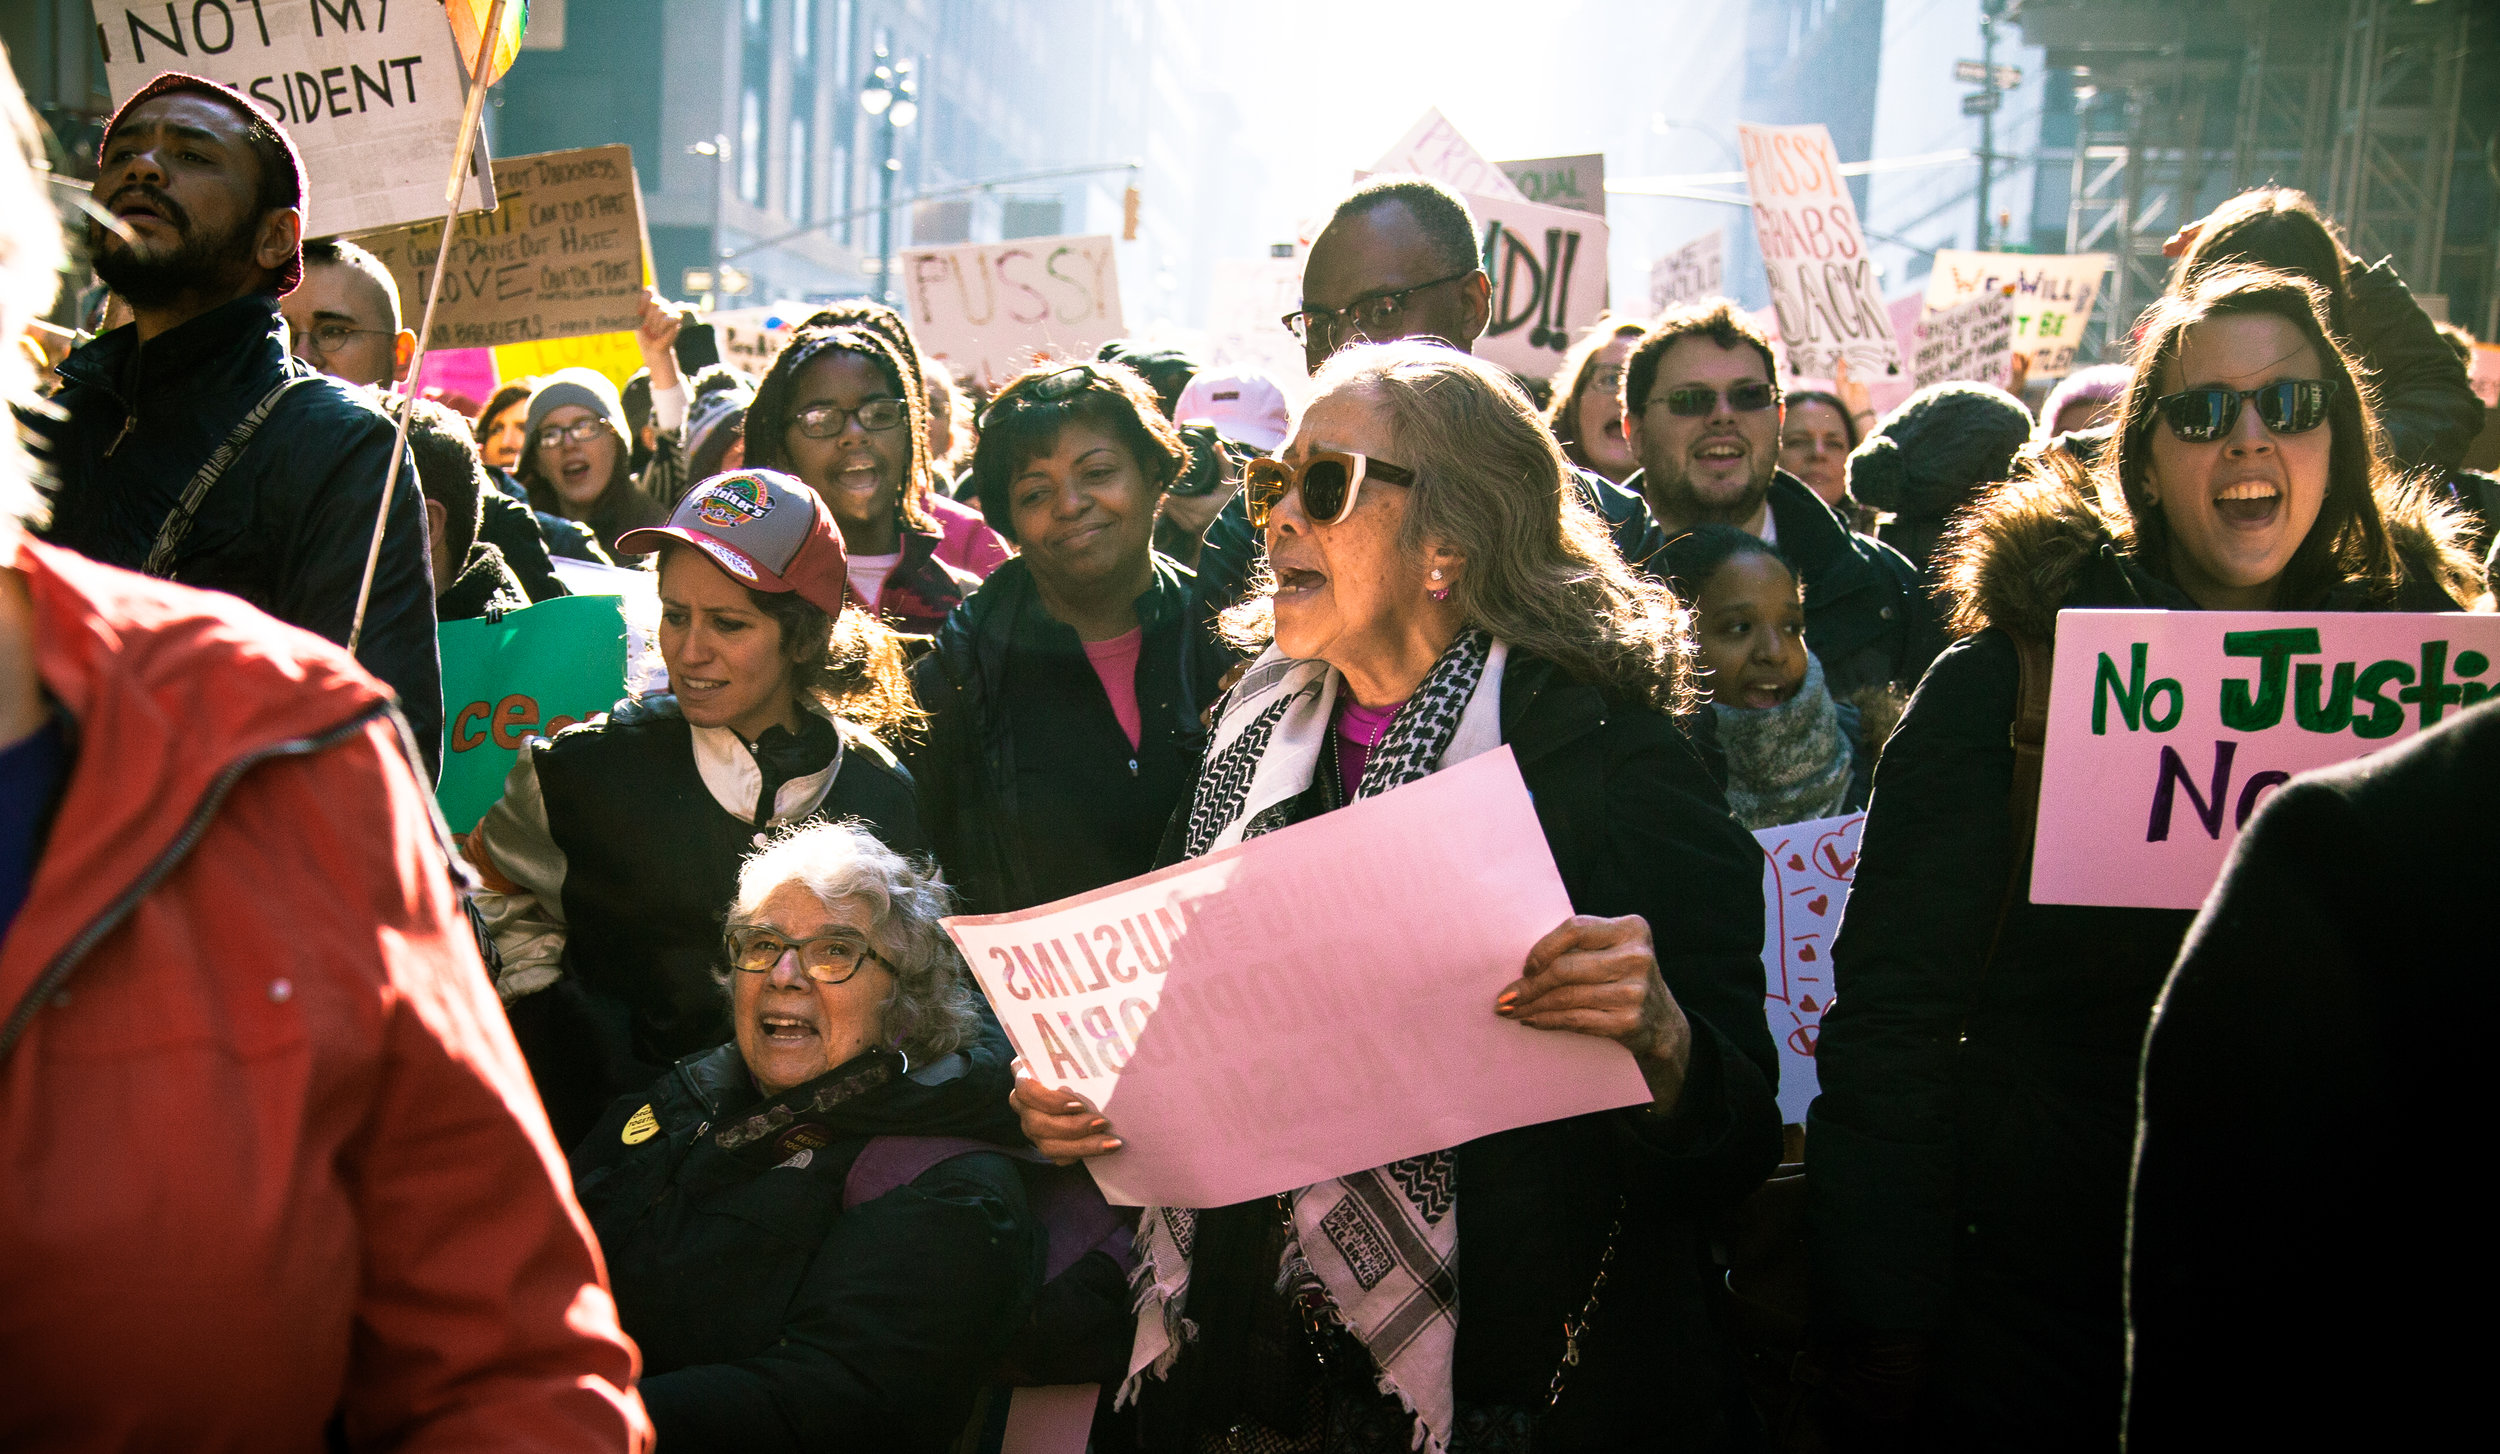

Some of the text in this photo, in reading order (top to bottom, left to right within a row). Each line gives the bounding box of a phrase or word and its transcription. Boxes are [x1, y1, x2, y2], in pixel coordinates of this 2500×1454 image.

[126, 0, 271, 63] NOT
[224, 56, 422, 124] SIDENT
[415, 262, 534, 305] LOVE
[913, 247, 1109, 326] PUSSY
[1766, 257, 1889, 347] BACK
[2091, 627, 2500, 739] No Justi
